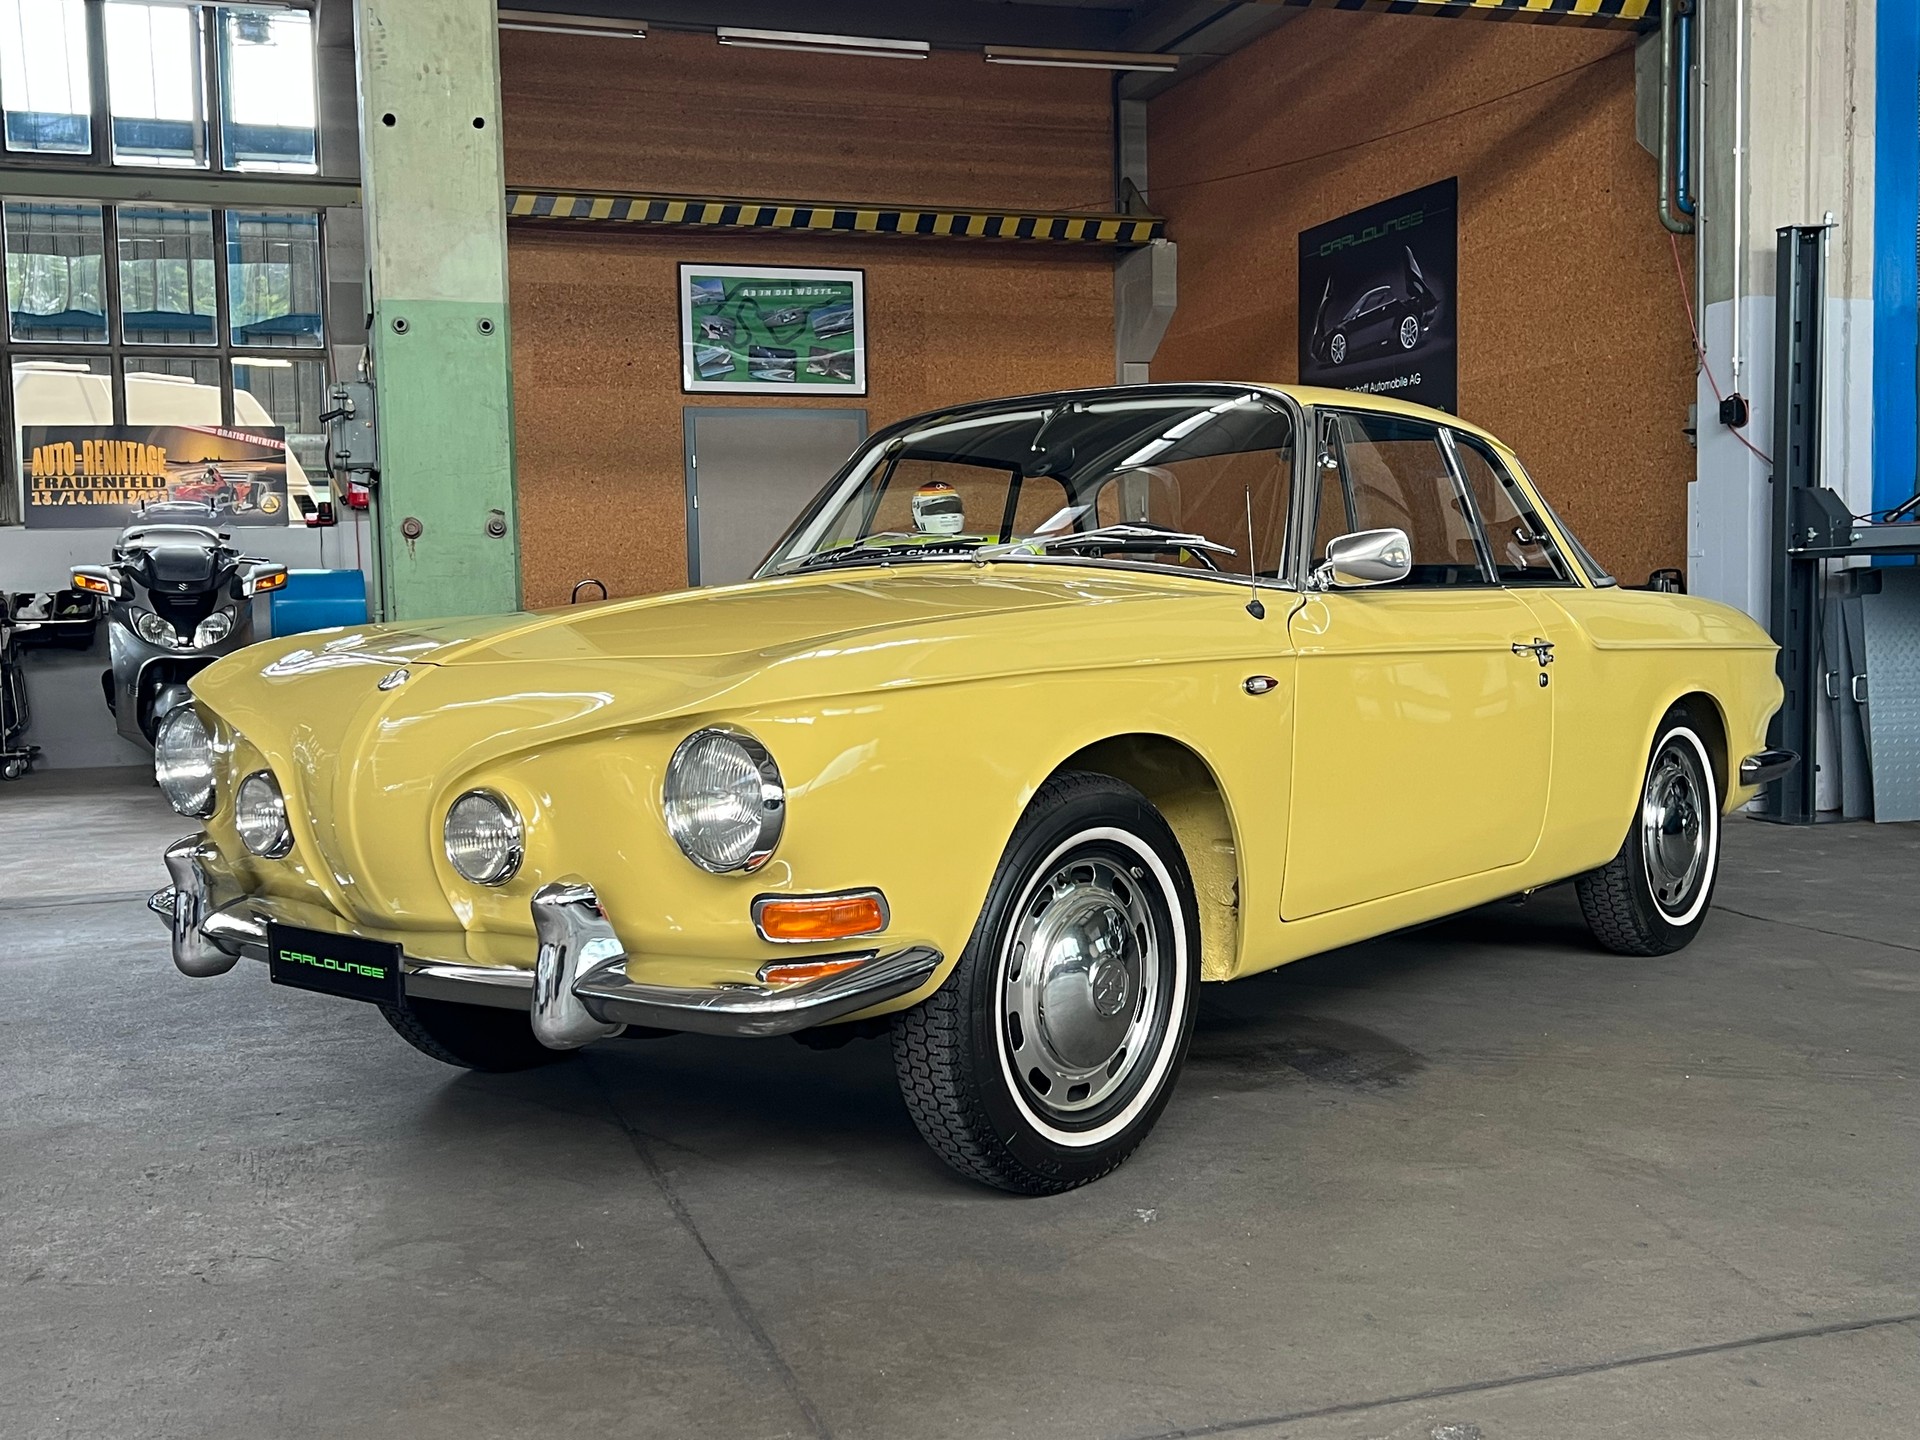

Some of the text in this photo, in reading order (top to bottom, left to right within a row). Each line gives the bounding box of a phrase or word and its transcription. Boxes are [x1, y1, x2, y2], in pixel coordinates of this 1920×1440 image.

[1320, 210, 1424, 257] CARLOUNGE
[1369, 376, 1408, 393] Automobile
[1409, 372, 1422, 386] AG
[217, 428, 280, 448] GRATIS EINTRITT
[32, 440, 167, 476] AUTO-RENNTAGE
[32, 476, 167, 489] FRAUENFELD
[280, 950, 385, 979] CARLOUNGE
